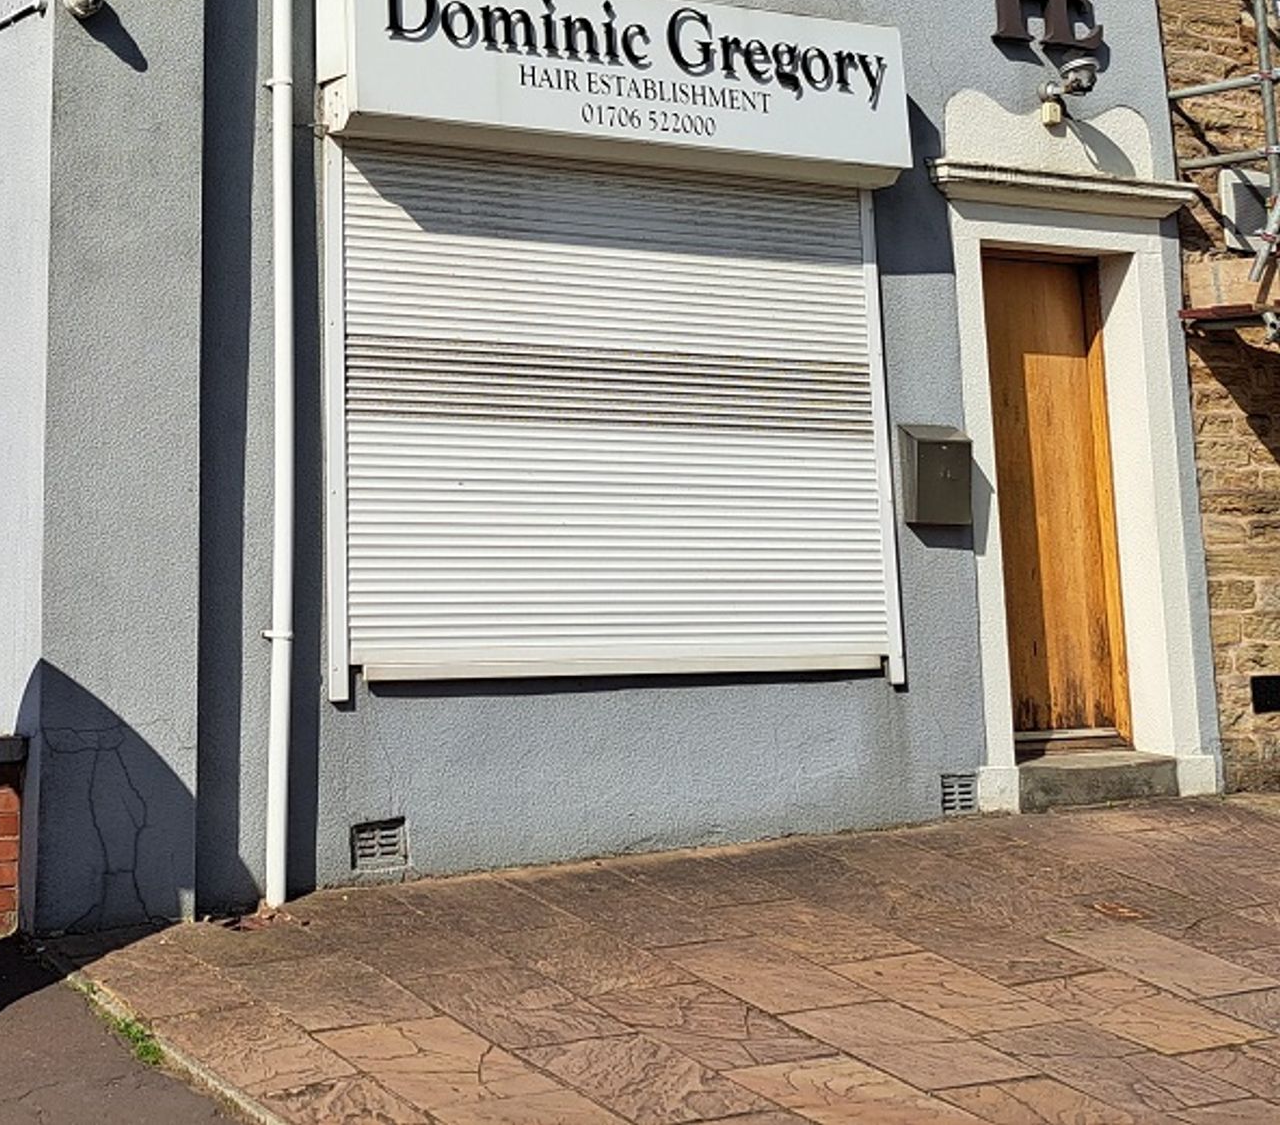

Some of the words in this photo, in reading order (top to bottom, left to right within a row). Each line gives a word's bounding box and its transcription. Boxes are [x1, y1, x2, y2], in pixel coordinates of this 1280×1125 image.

[666, 7, 887, 111] Gregory
[519, 64, 581, 93] HAIR
[586, 72, 772, 114] ESTABLISHMENT
[581, 102, 642, 130] 01706
[648, 110, 717, 137] 522000
